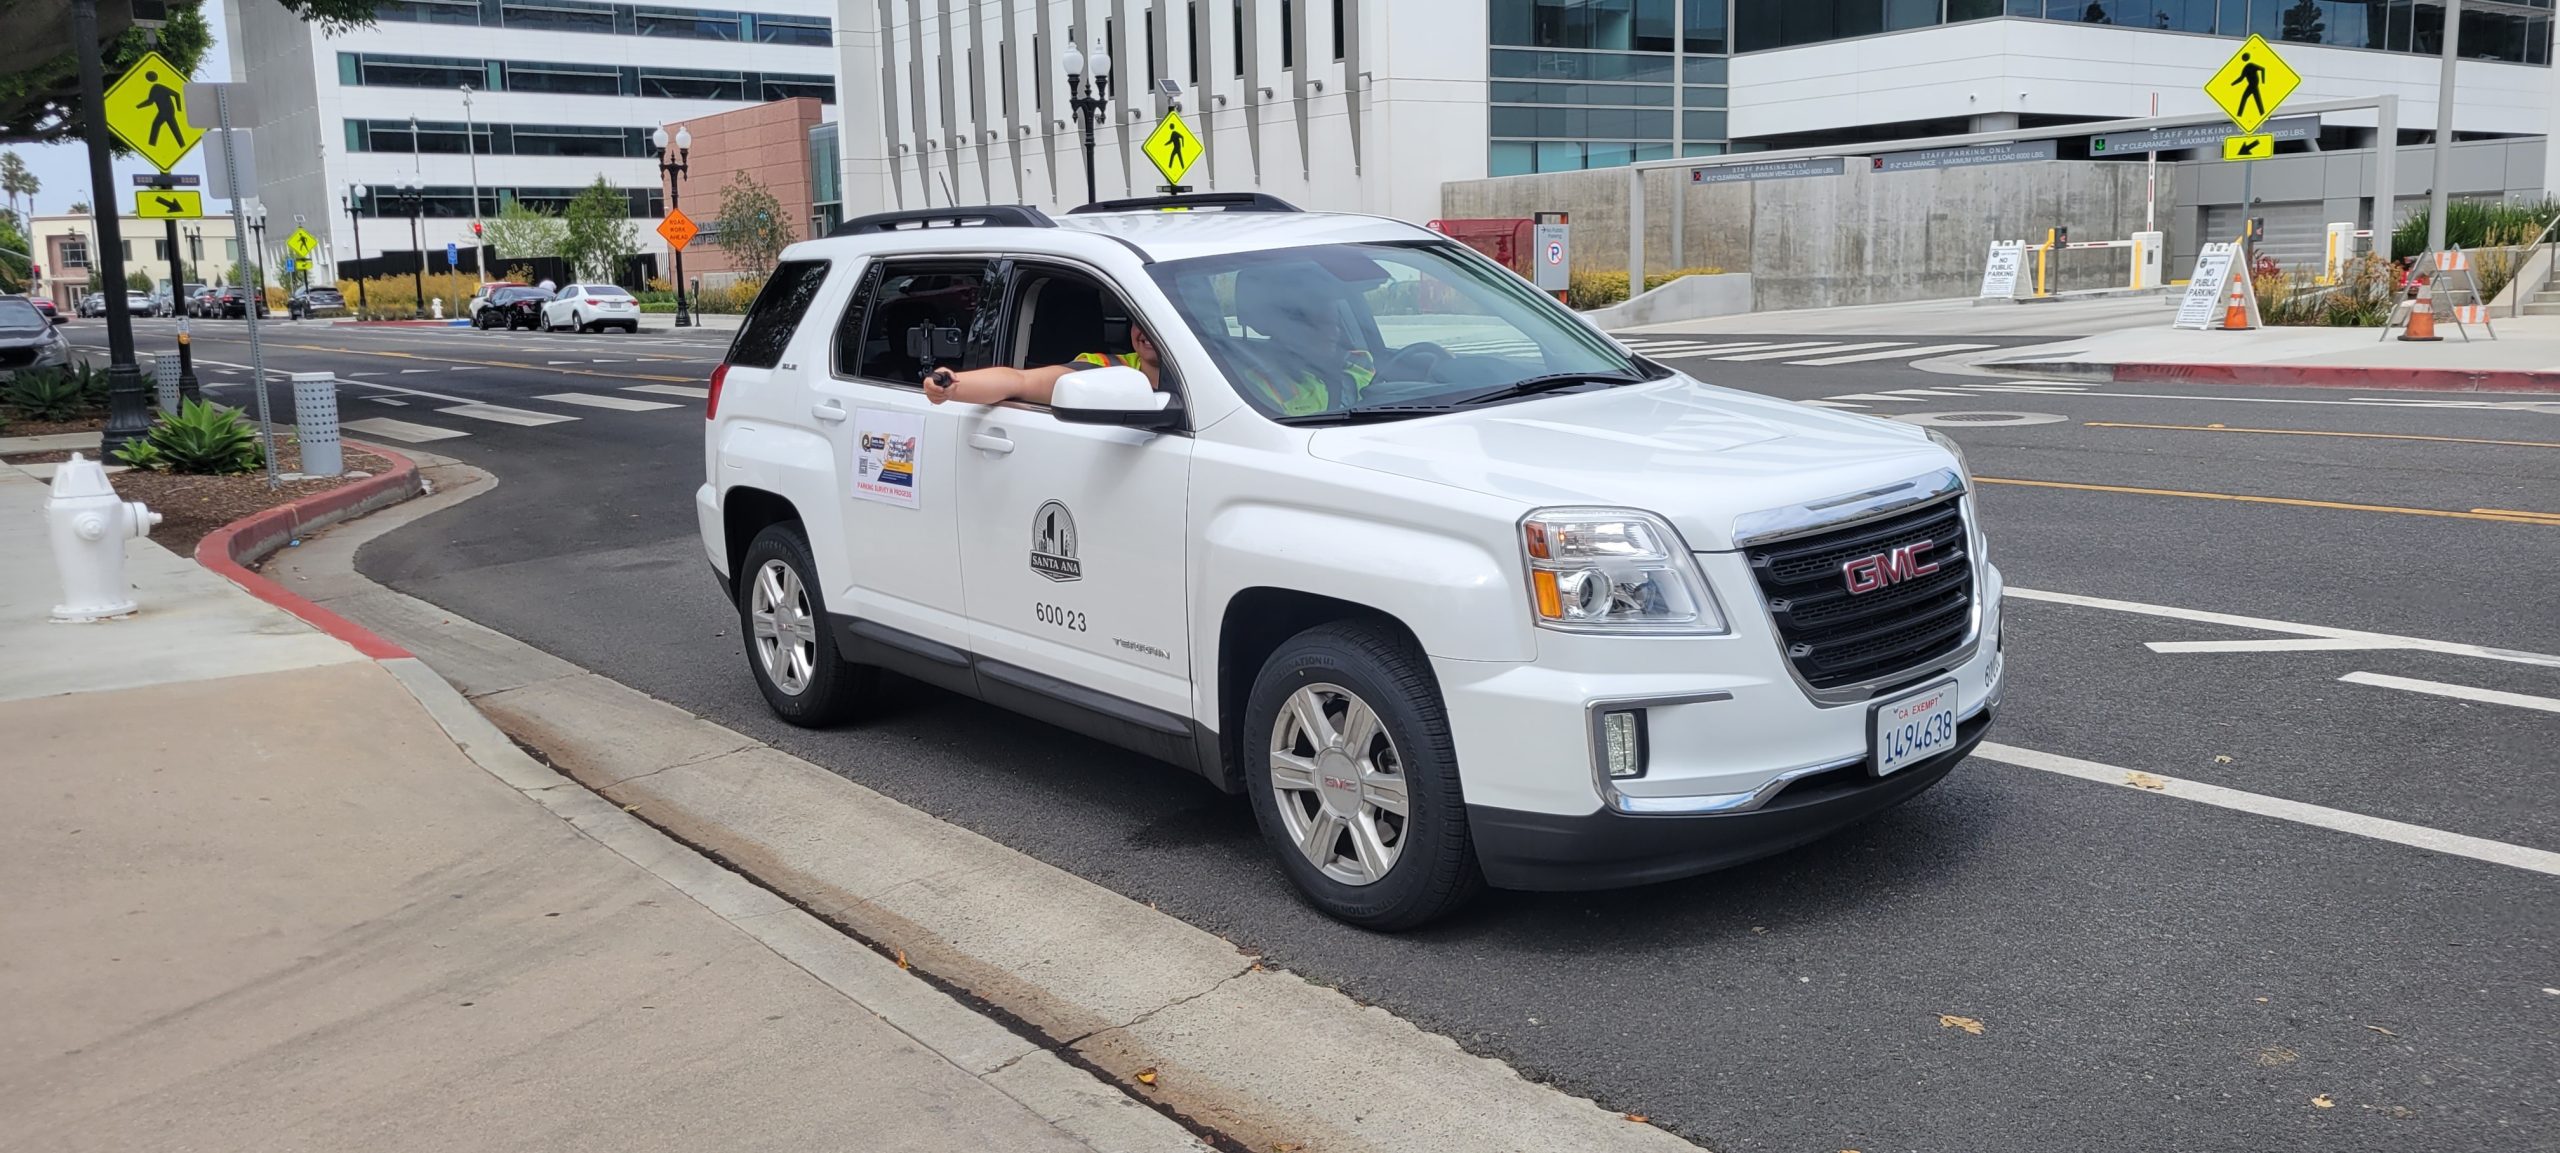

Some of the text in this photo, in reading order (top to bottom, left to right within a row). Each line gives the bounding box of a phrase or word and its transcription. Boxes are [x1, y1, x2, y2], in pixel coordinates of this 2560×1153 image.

[2153, 131, 2182, 140] STAFF
[2187, 126, 2232, 137] PARKING
[2129, 140, 2171, 149] CLEARANCE
[2180, 136, 2216, 145] MAXIMUM
[1921, 146, 2012, 160] STAFF PARKING ONLY
[1756, 163, 1786, 171] PARKING
[1788, 162, 1808, 170] ONLY
[1902, 159, 1936, 168] CLEARANCE
[1943, 157, 1971, 166] MAXIMUM
[1972, 155, 1998, 164] VEHICLE
[2204, 268, 2215, 277] NO
[2194, 278, 2218, 287] PUBLIC
[2188, 288, 2217, 297] PARKING
[1032, 555, 1079, 573] SANTA ANA
[1843, 539, 1940, 595] GMC
[1112, 637, 1171, 660] TERRAIN
[1898, 697, 1939, 720] CA EXEMPT
[1885, 710, 1952, 764] 1494638
